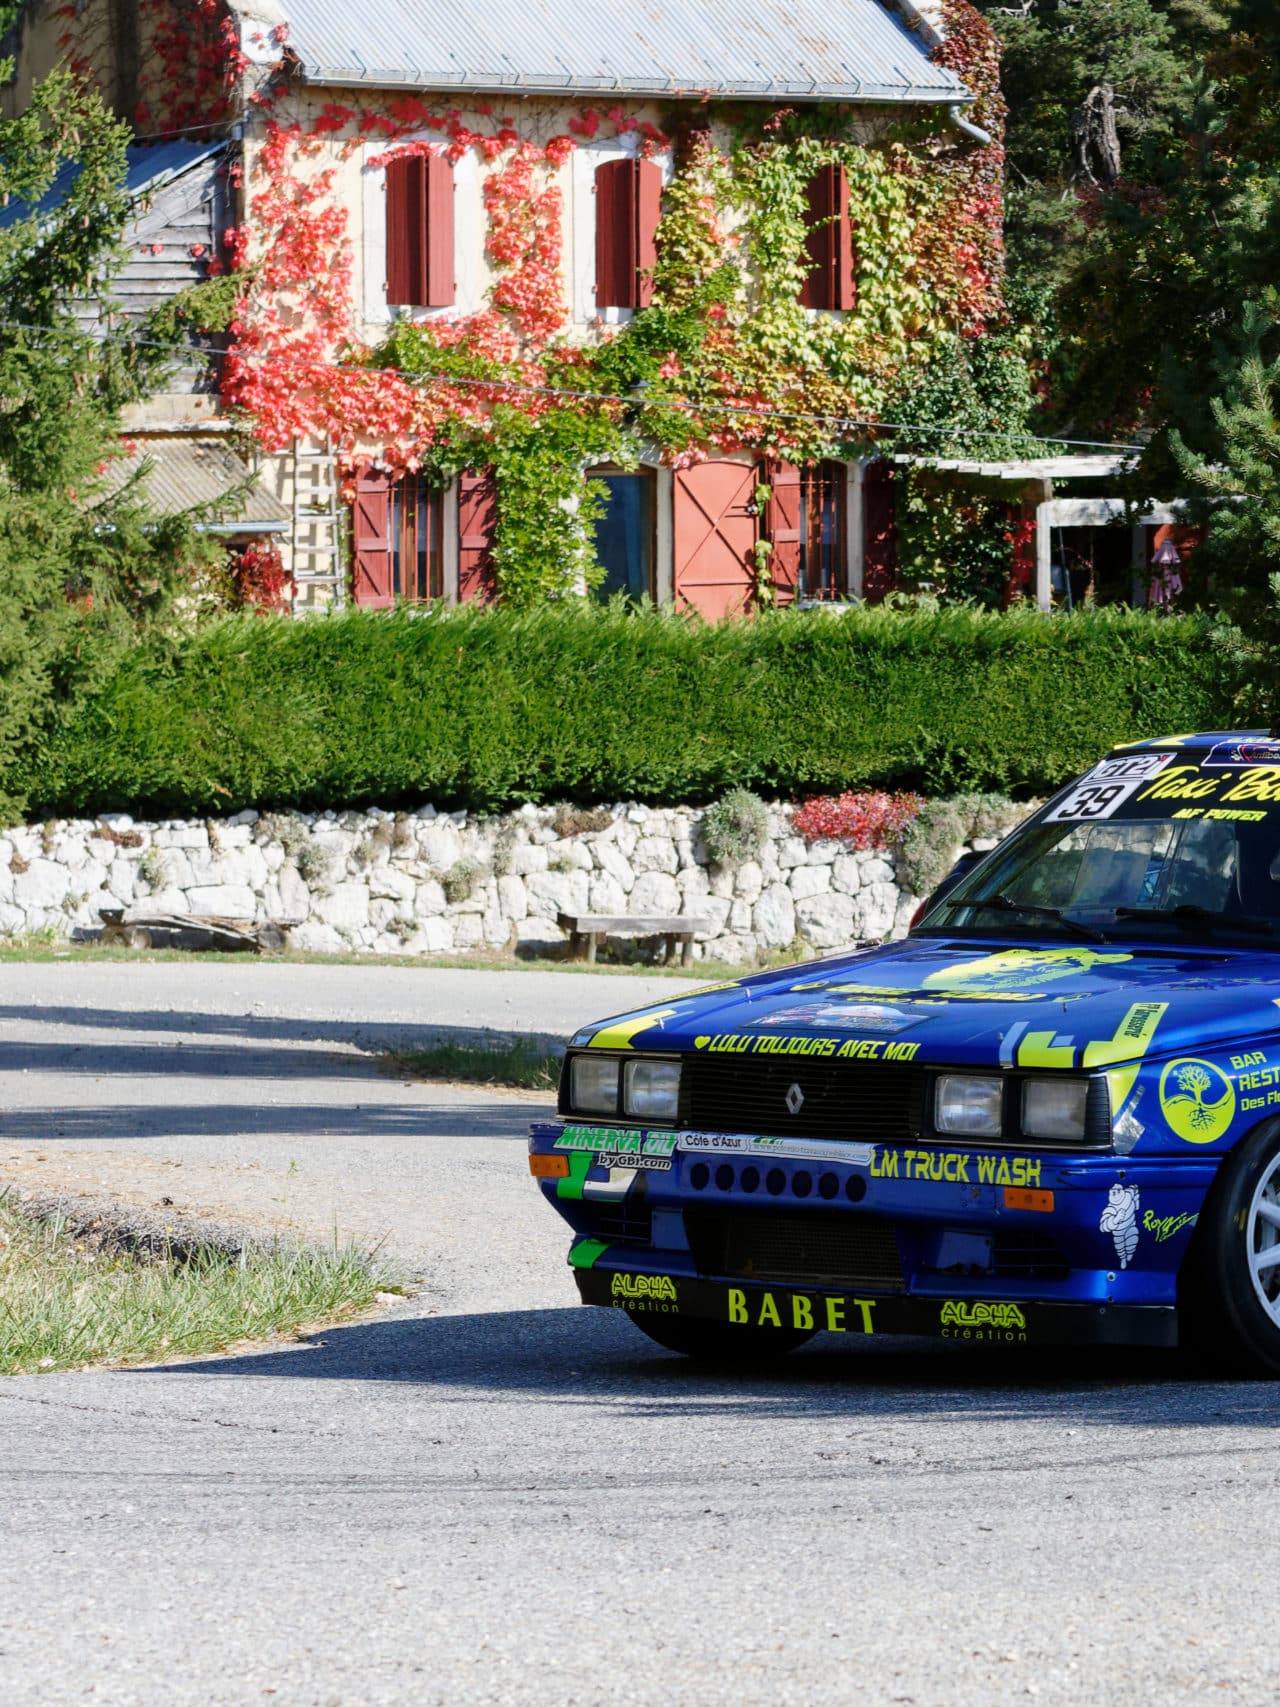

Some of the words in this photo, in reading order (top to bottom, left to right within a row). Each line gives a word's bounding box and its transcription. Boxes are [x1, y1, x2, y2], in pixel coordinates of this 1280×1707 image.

[1058, 785, 1125, 818] 39
[1203, 809, 1268, 821] POWER
[708, 1034, 755, 1053] LULU
[752, 1035, 841, 1056] TOUJOURS
[837, 1038, 886, 1060] AVEC
[881, 1041, 922, 1061] MOI
[1230, 1051, 1267, 1070] BAR
[1240, 1097, 1265, 1111] Des
[556, 1125, 642, 1153] MINERVA
[685, 1134, 709, 1146] Côte
[711, 1135, 742, 1148] d'Azur
[600, 1153, 616, 1168] by
[869, 1149, 899, 1178] LM
[903, 1150, 970, 1183] TRUCK
[977, 1155, 1041, 1188] WASH
[611, 1272, 677, 1302] ALPHA
[612, 1299, 680, 1313] création
[728, 1287, 878, 1335] BABET
[941, 1301, 1026, 1330] ALPHA
[941, 1327, 1027, 1341] création
